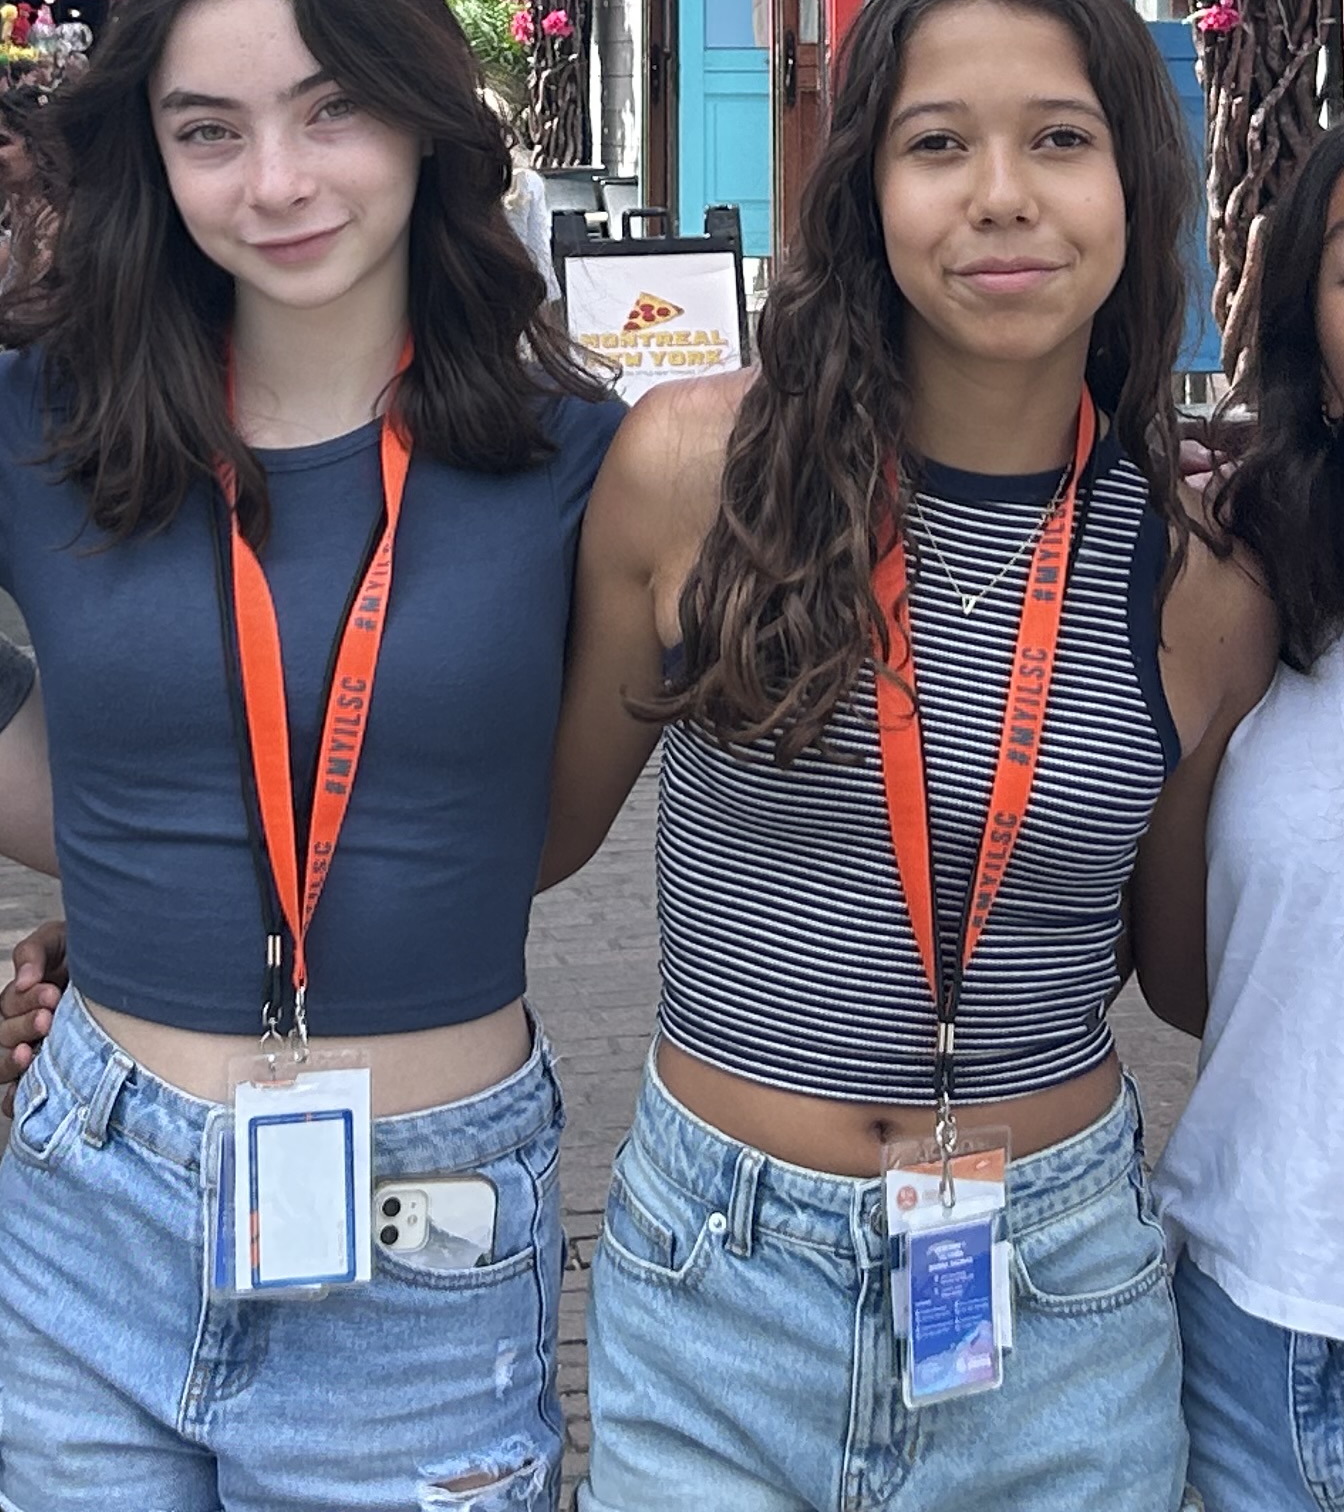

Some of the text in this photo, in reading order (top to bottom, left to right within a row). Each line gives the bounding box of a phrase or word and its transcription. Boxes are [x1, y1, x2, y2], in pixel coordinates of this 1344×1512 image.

[579, 329, 729, 349] MONTREAL
[649, 348, 724, 368] YORK
[324, 676, 368, 796] #MYILSC
[1005, 646, 1048, 767] #MYILSC
